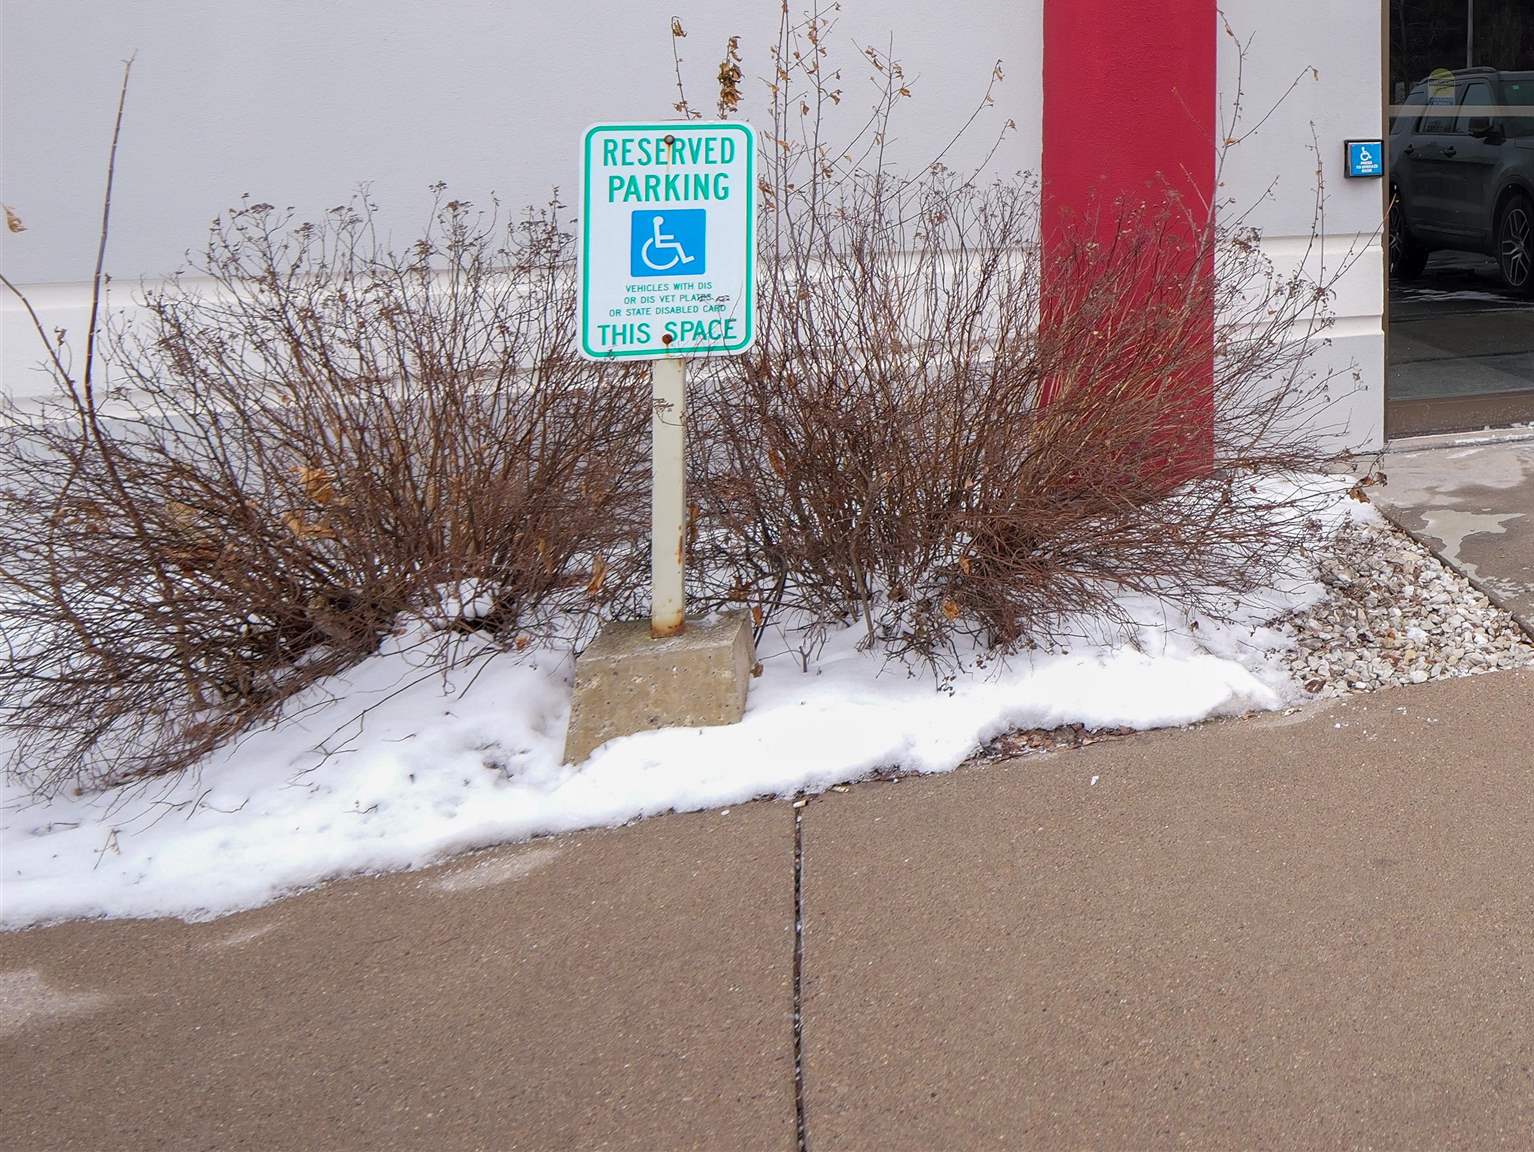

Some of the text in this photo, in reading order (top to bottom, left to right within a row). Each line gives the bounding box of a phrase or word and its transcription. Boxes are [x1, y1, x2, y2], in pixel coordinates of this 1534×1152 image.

[603, 137, 735, 166] RESERVED
[608, 173, 729, 202] PARKING
[625, 283, 669, 292] VEHICLES
[673, 282, 694, 291] WITH
[623, 296, 636, 304] OR
[640, 295, 655, 303] DIS
[660, 294, 676, 302] VET
[608, 304, 727, 317] OR STATE DISABLED CARD
[597, 318, 738, 346] THIS SPACE
